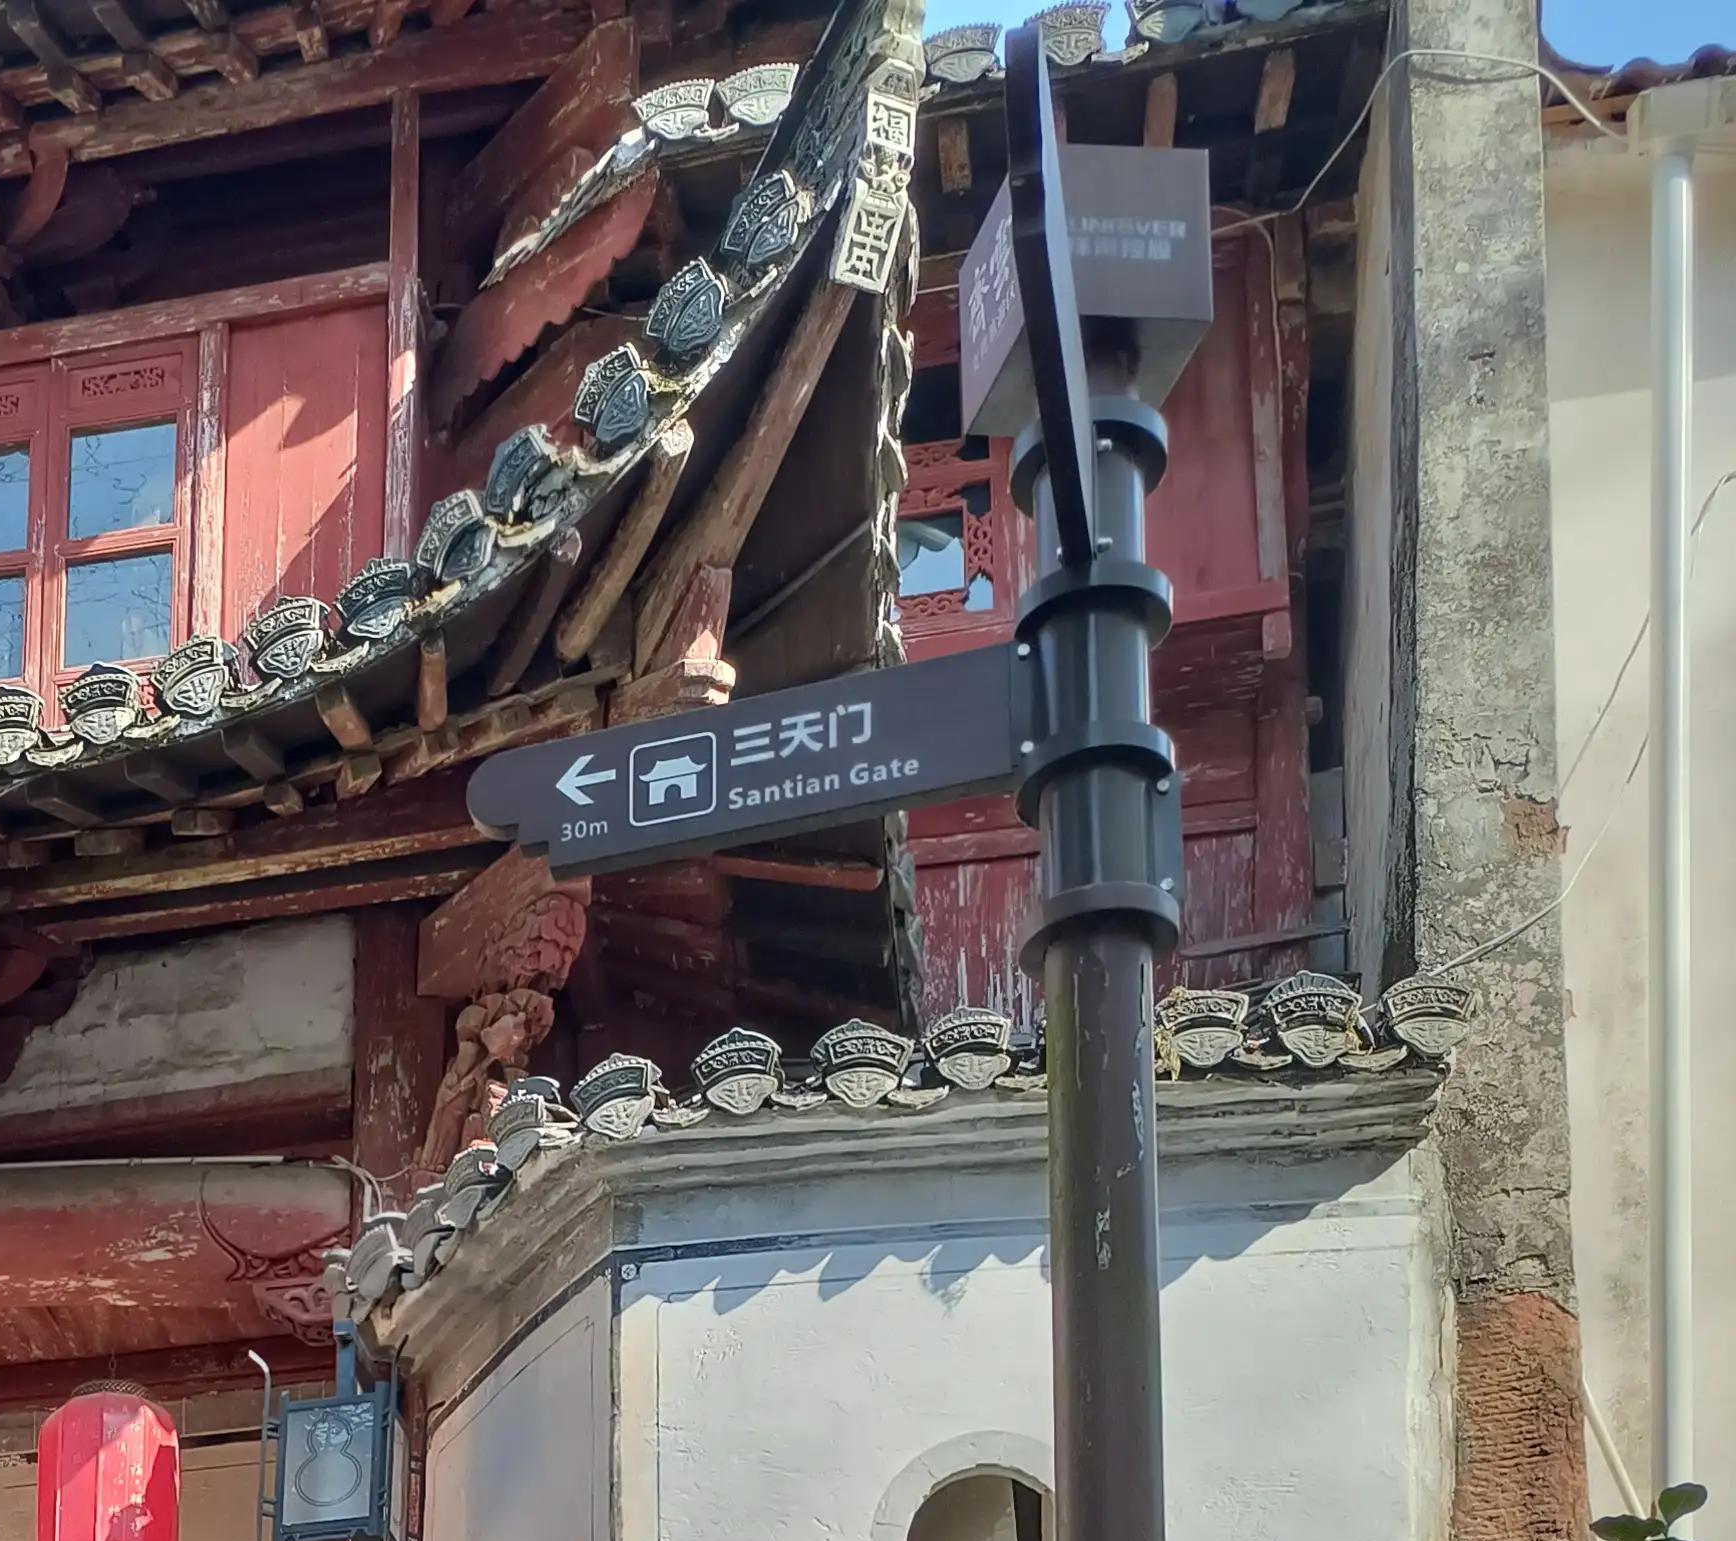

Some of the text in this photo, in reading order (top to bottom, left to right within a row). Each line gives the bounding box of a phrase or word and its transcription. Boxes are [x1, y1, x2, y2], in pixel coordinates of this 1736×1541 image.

[729, 702, 873, 766] 三天门
[728, 756, 920, 810] Santian Gate
[561, 818, 608, 842] 30m
